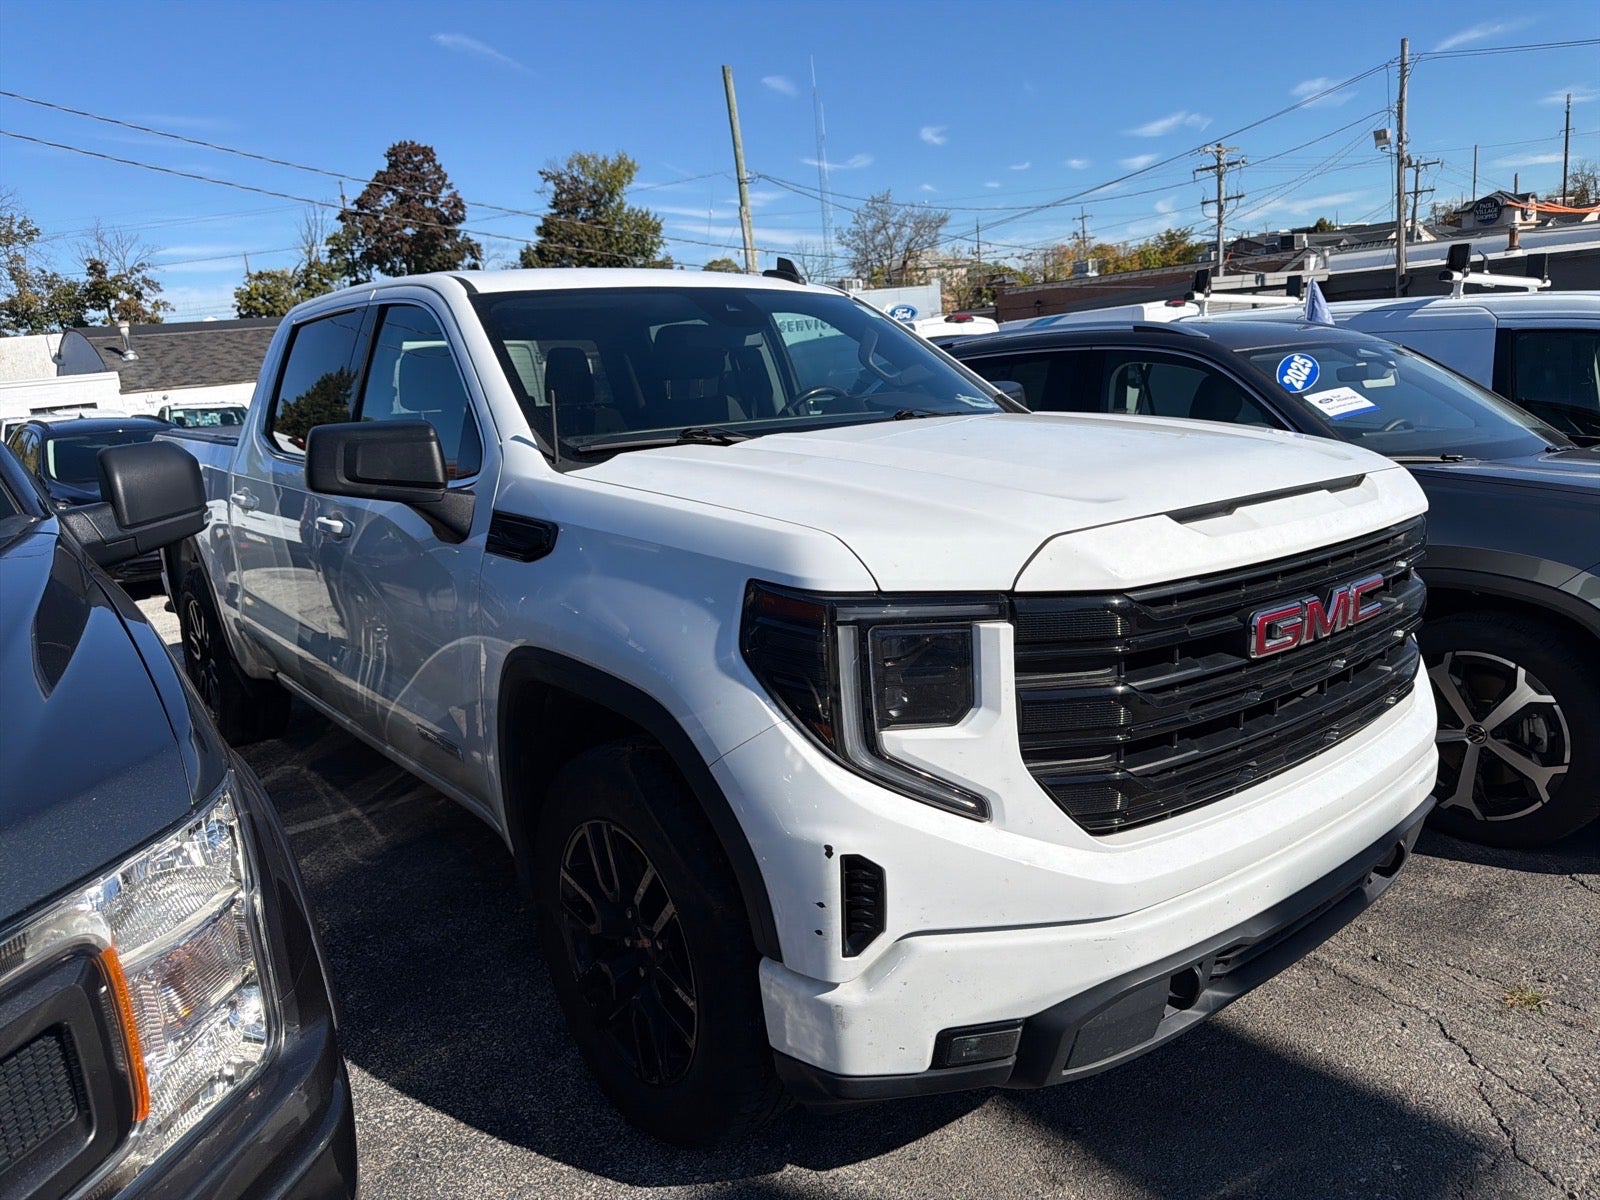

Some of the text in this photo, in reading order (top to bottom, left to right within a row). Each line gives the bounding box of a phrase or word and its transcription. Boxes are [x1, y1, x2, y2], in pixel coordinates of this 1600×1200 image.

[779, 319, 833, 333] SERVIC
[893, 308, 912, 320] Ford
[1283, 355, 1313, 390] 2025
[1250, 573, 1384, 658] GMC
